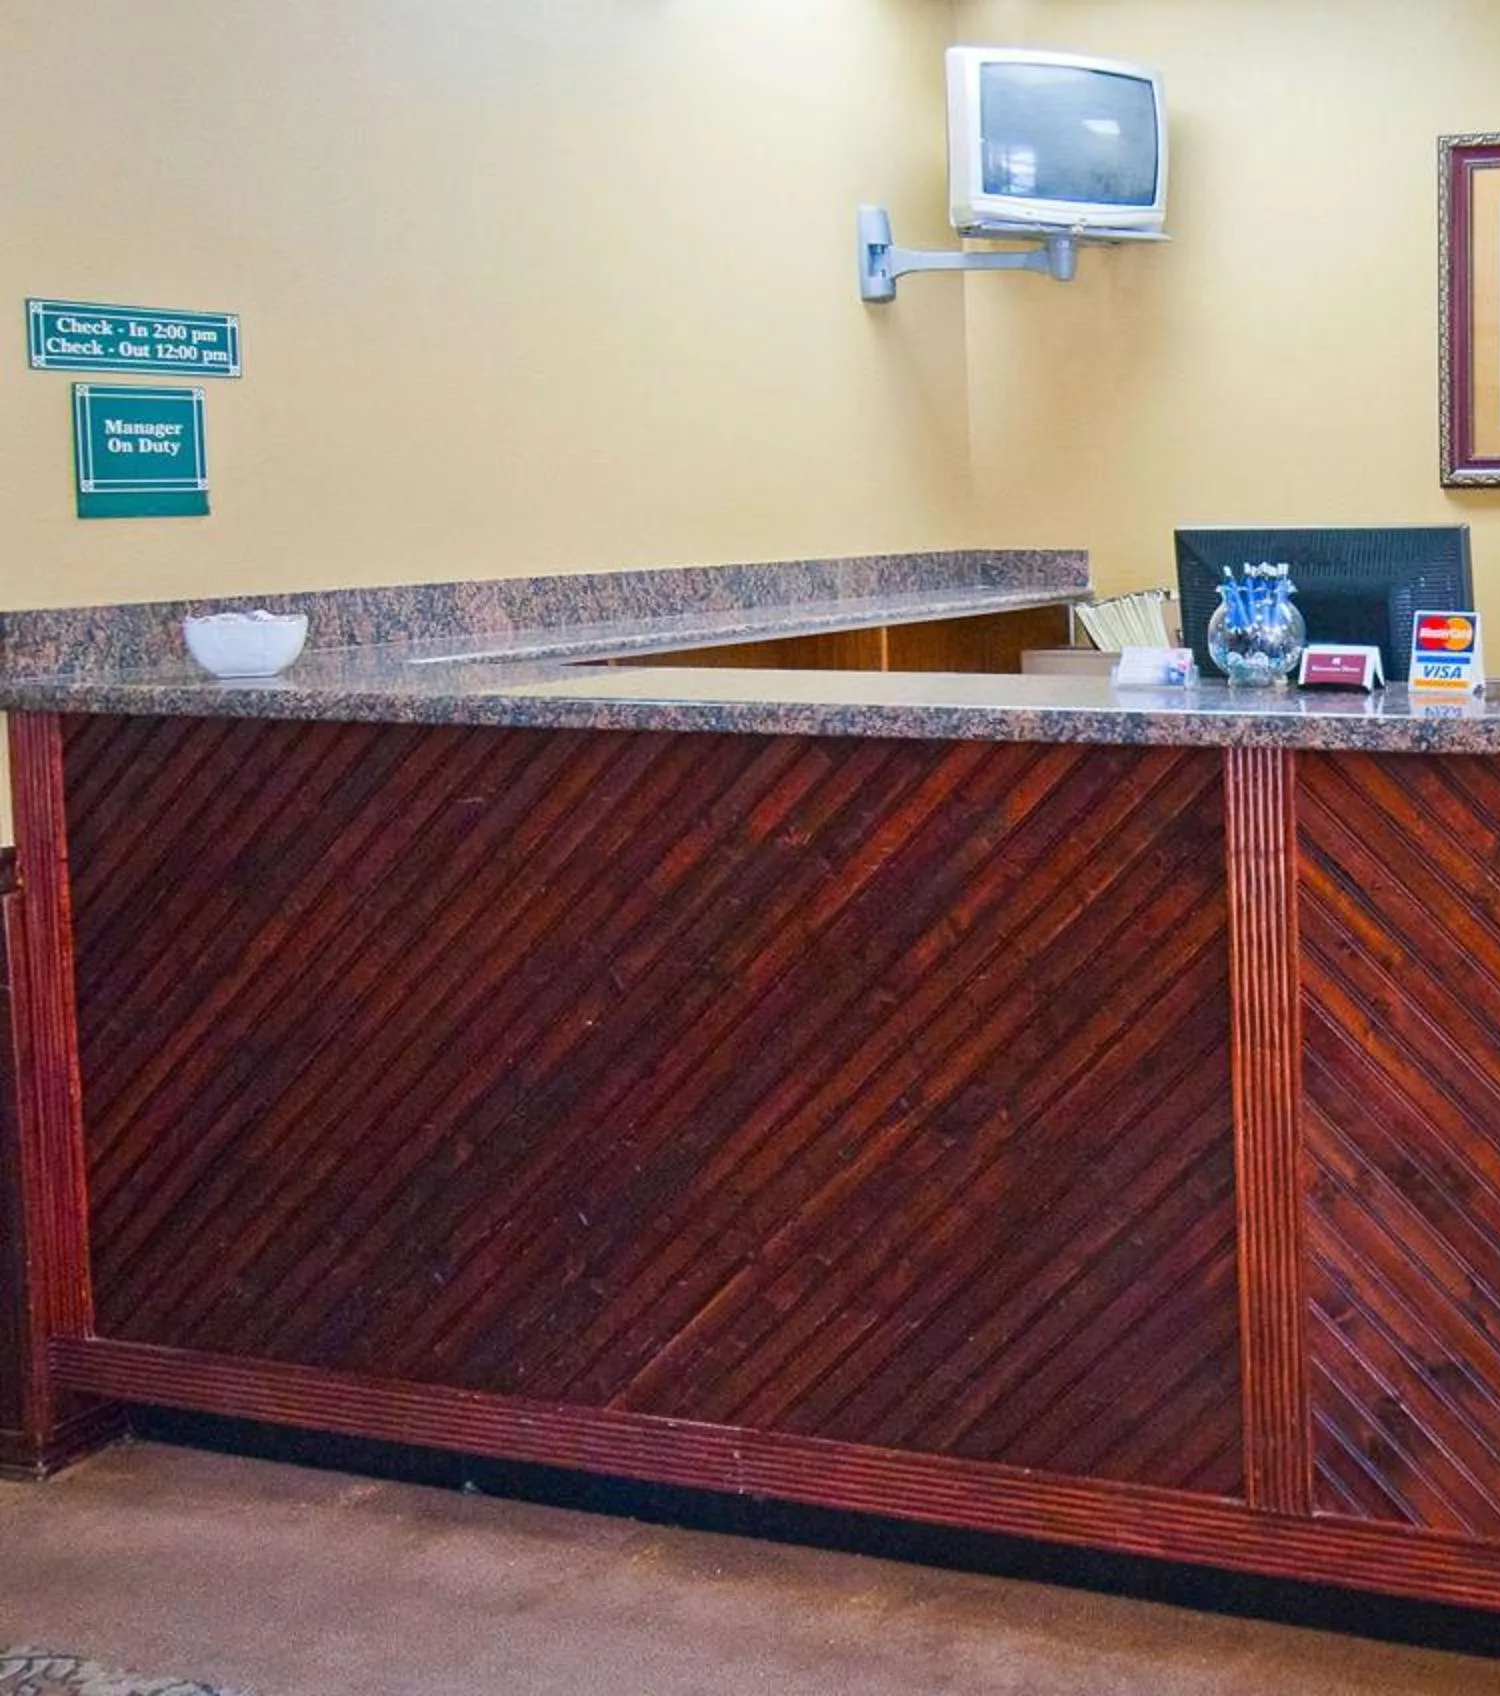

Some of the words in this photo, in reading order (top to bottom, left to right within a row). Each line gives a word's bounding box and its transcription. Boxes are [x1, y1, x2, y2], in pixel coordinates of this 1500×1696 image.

[56, 317, 113, 336] Check
[128, 321, 149, 337] In
[153, 323, 187, 340] 2:00
[191, 329, 218, 344] pm
[46, 337, 104, 355] Check
[118, 341, 150, 358] Out
[155, 343, 198, 361] 12:00
[202, 349, 228, 365] pm
[104, 419, 184, 438] Manager
[107, 437, 133, 453] On
[138, 437, 181, 457] Duty
[1422, 665, 1463, 680] VISA
